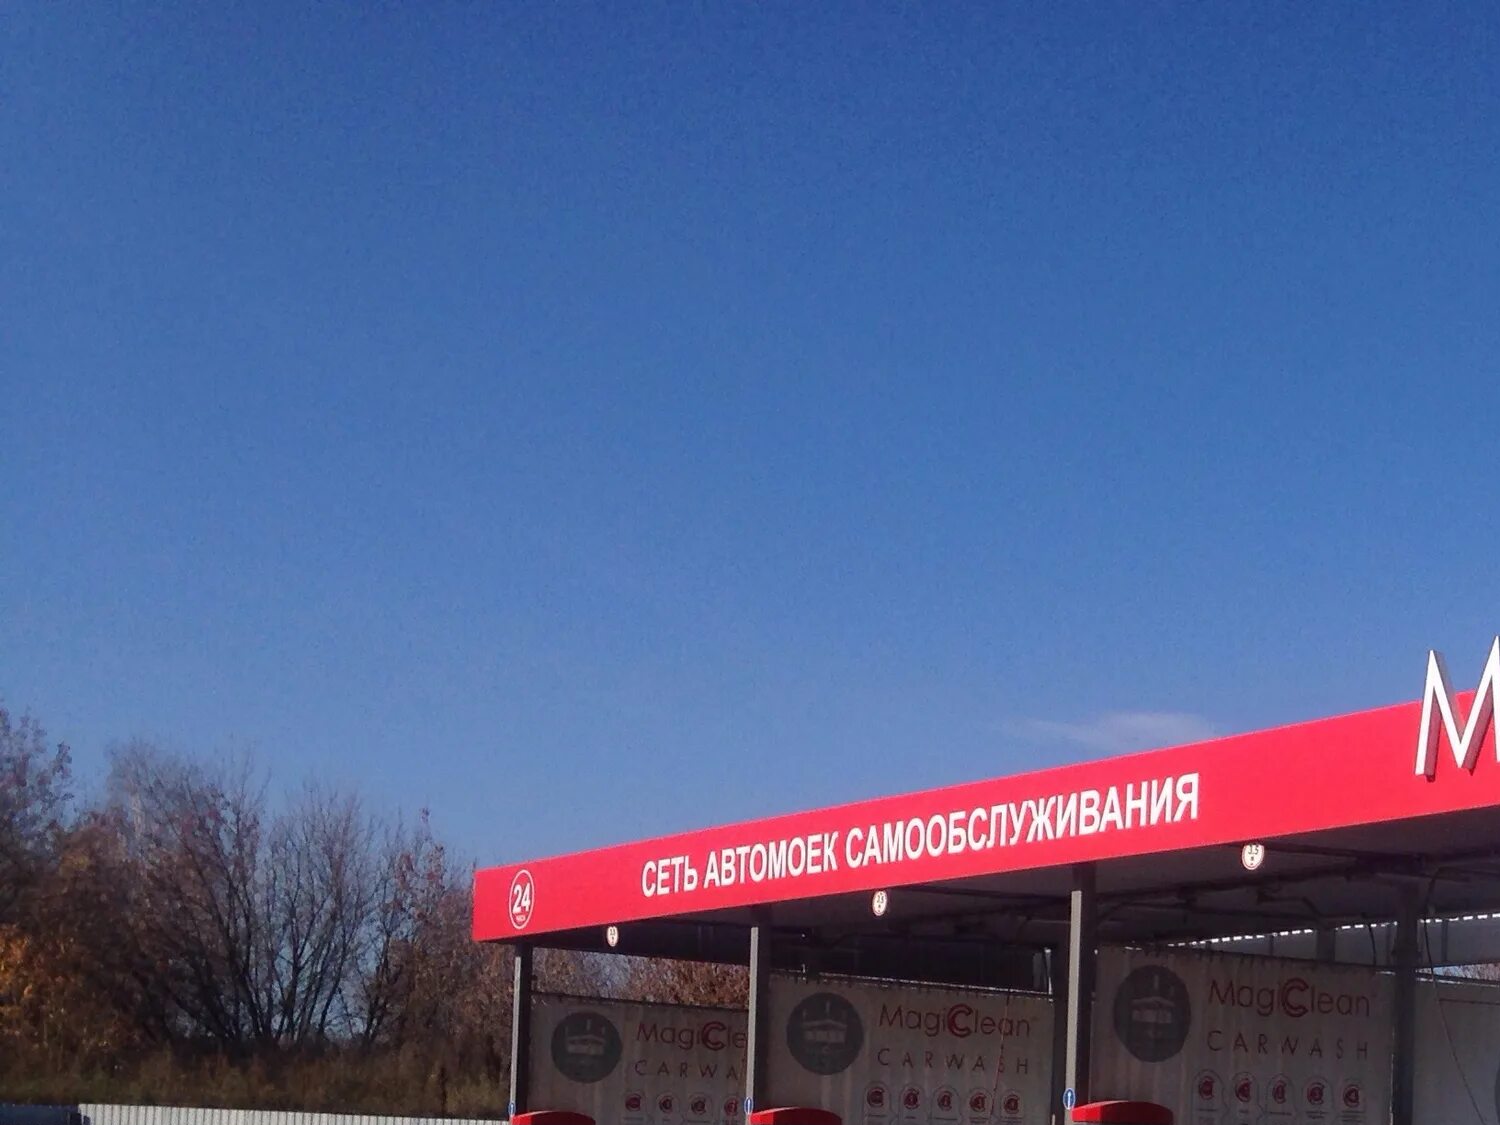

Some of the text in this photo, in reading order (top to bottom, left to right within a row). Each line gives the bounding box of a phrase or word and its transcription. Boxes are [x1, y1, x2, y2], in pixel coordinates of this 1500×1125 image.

[641, 772, 1200, 898] СЕТЬ АВТОМОЕК САМООБСЛУЖИВАНИЯ
[512, 882, 531, 914] 24
[1208, 977, 1370, 1018] MagiClean
[636, 1021, 746, 1051] MagiCle
[878, 1003, 1030, 1038] MagiClean
[634, 1059, 739, 1081] CARWA
